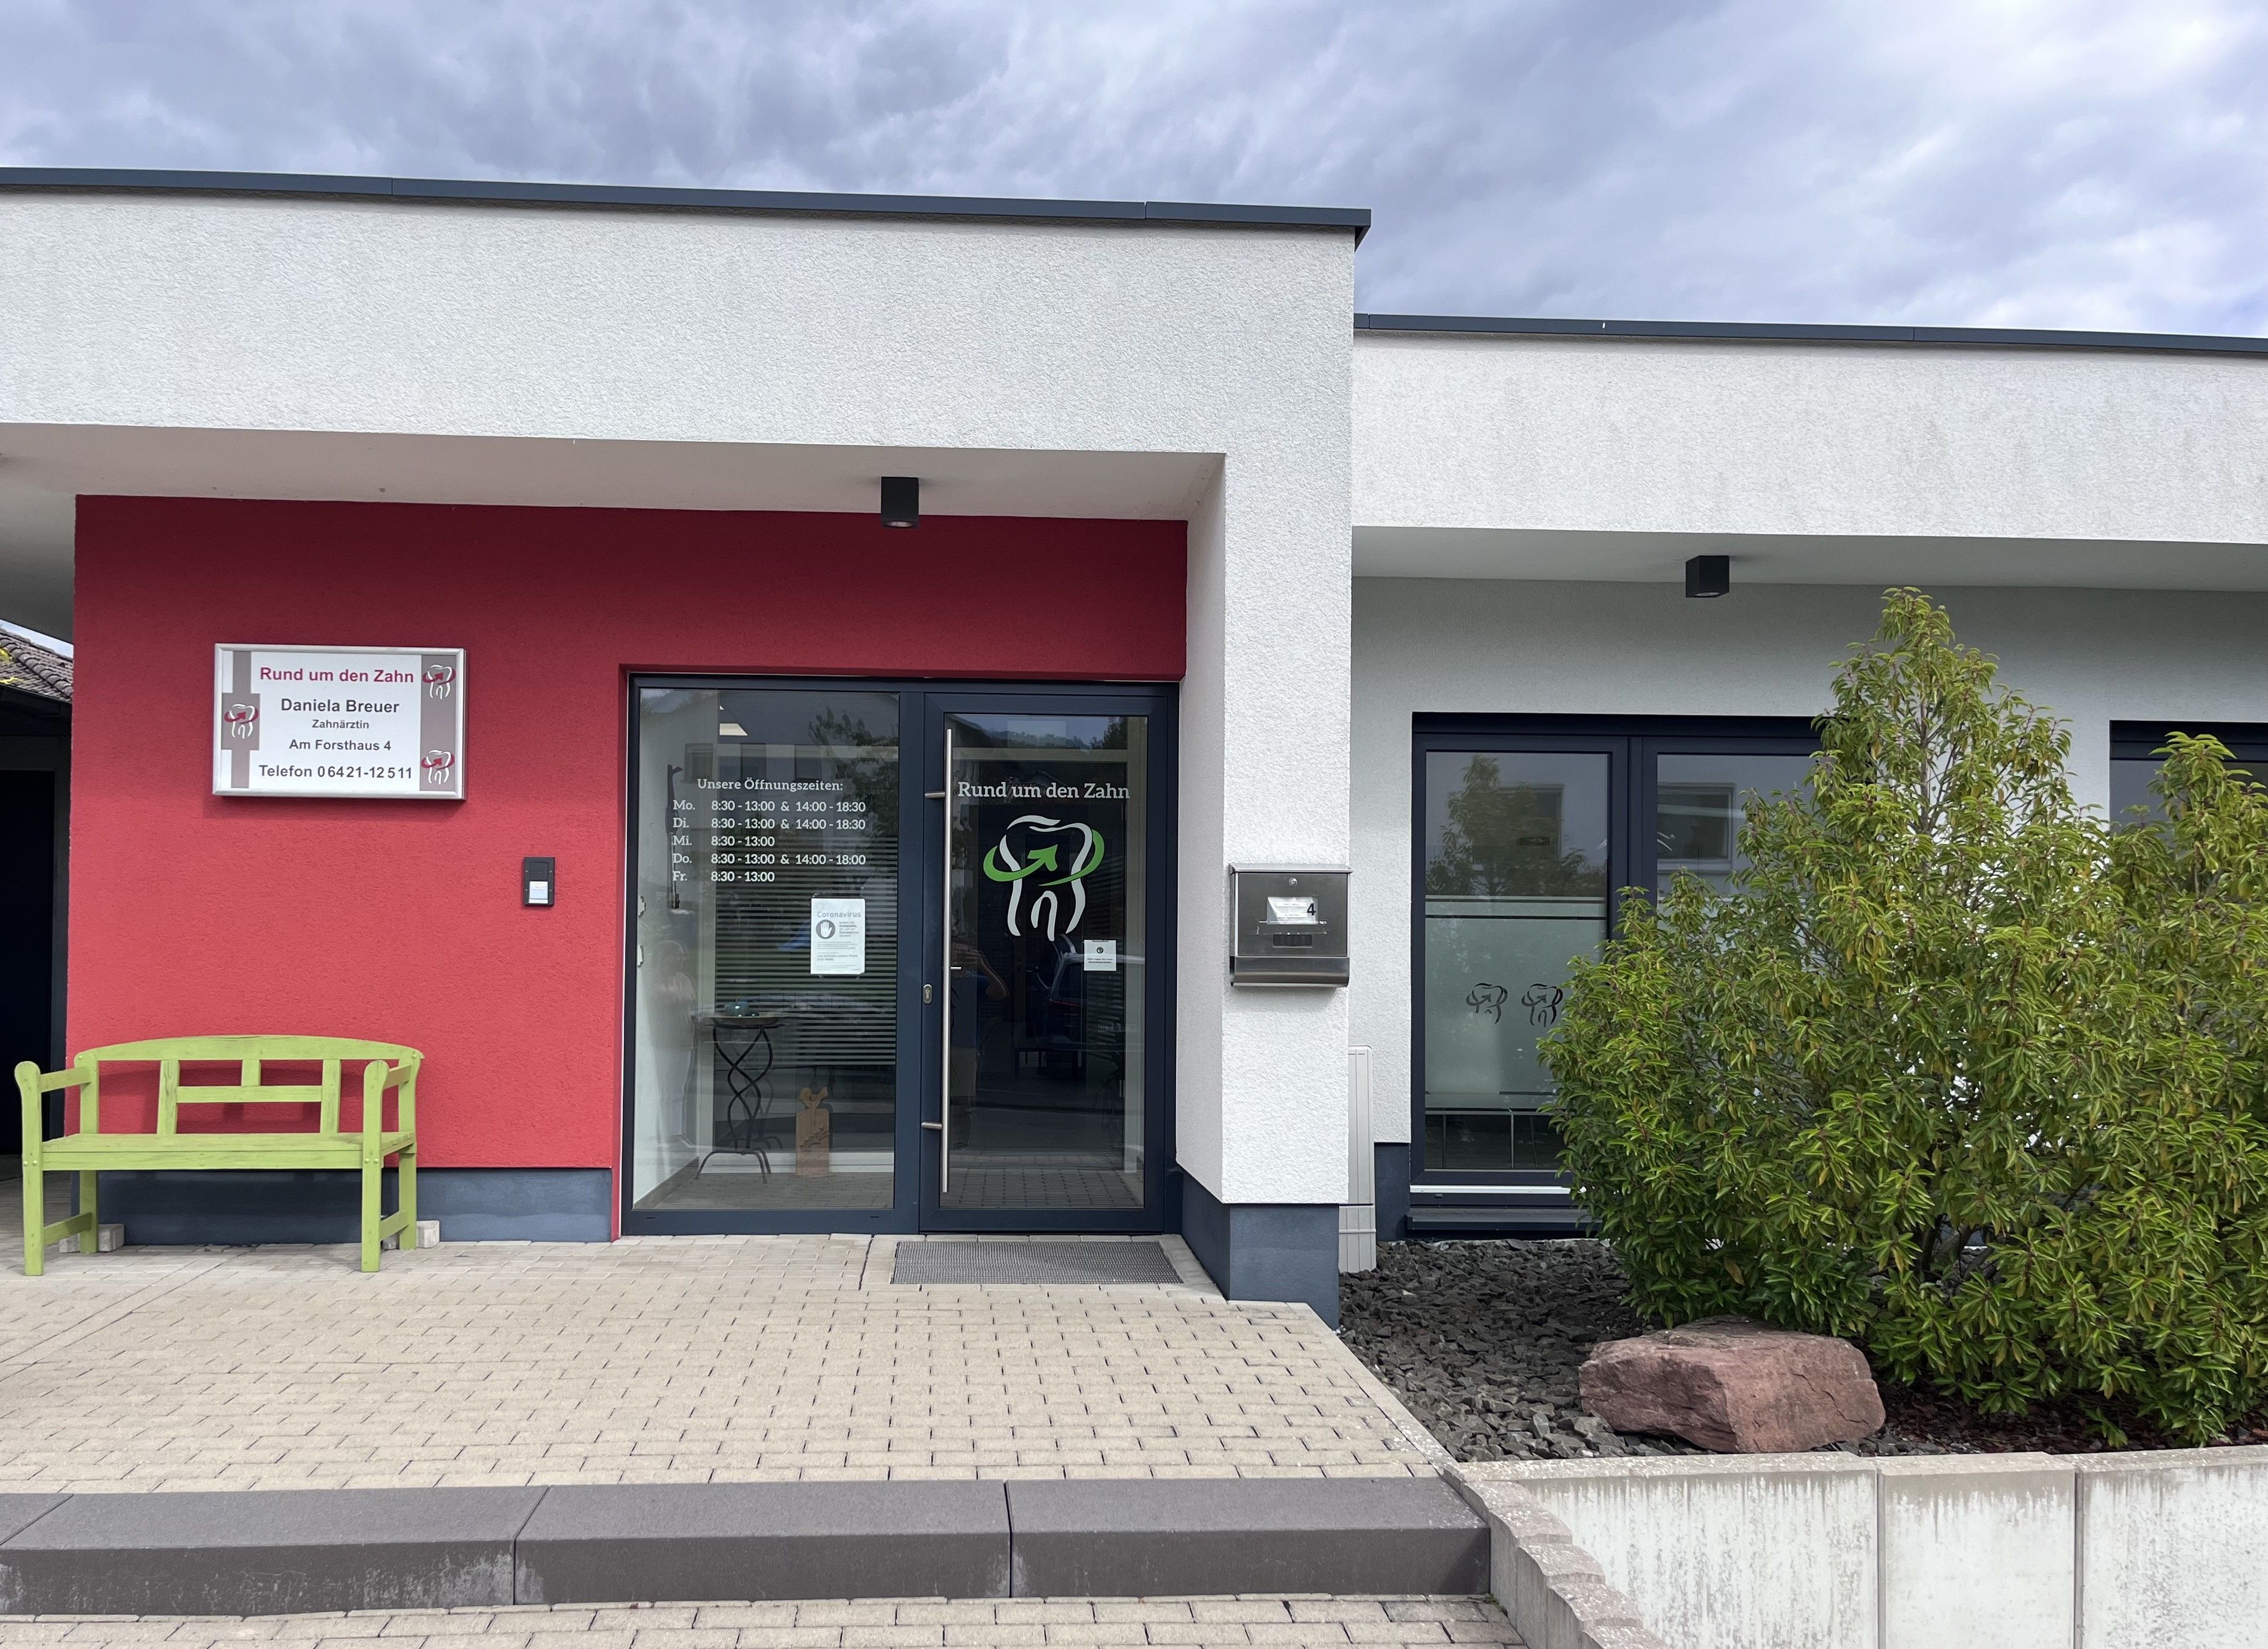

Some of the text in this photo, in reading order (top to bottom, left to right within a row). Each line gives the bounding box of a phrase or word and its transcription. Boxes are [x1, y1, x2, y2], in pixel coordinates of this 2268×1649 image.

[260, 667, 414, 683] Rund um den Zahn
[281, 698, 400, 713] Daniela Breuer
[312, 719, 370, 729] Zahnärztin
[289, 740, 392, 750] Am Forsthaus 4
[259, 765, 312, 777] Telefon
[697, 777, 844, 792] Unsere Öffnungszeiten:
[958, 782, 1130, 799] Rund um den Zahn
[673, 800, 696, 811] Mo.
[711, 801, 736, 811] 8:30
[744, 801, 776, 811] 13:00
[780, 801, 790, 811] &
[796, 801, 827, 811] 14:00
[836, 801, 866, 812] 18:30
[673, 817, 690, 828] Di.
[711, 818, 736, 829] 8:30
[744, 819, 776, 829] 13:00
[780, 819, 790, 829] &
[796, 819, 827, 829] 14:00
[836, 819, 866, 830] 18:30
[672, 836, 693, 845] Mi.
[711, 836, 736, 846] 8:30
[744, 836, 776, 847] 13:00
[672, 853, 693, 863] Do.
[711, 854, 736, 864] 8:30
[744, 854, 776, 865] 13:00
[780, 854, 790, 865] &
[796, 854, 827, 865] 14:00
[836, 854, 866, 865] 18:00
[672, 871, 688, 881] Fr.
[711, 871, 736, 881] 8:30
[744, 872, 776, 882] 13:00
[1307, 903, 1316, 916] 4
